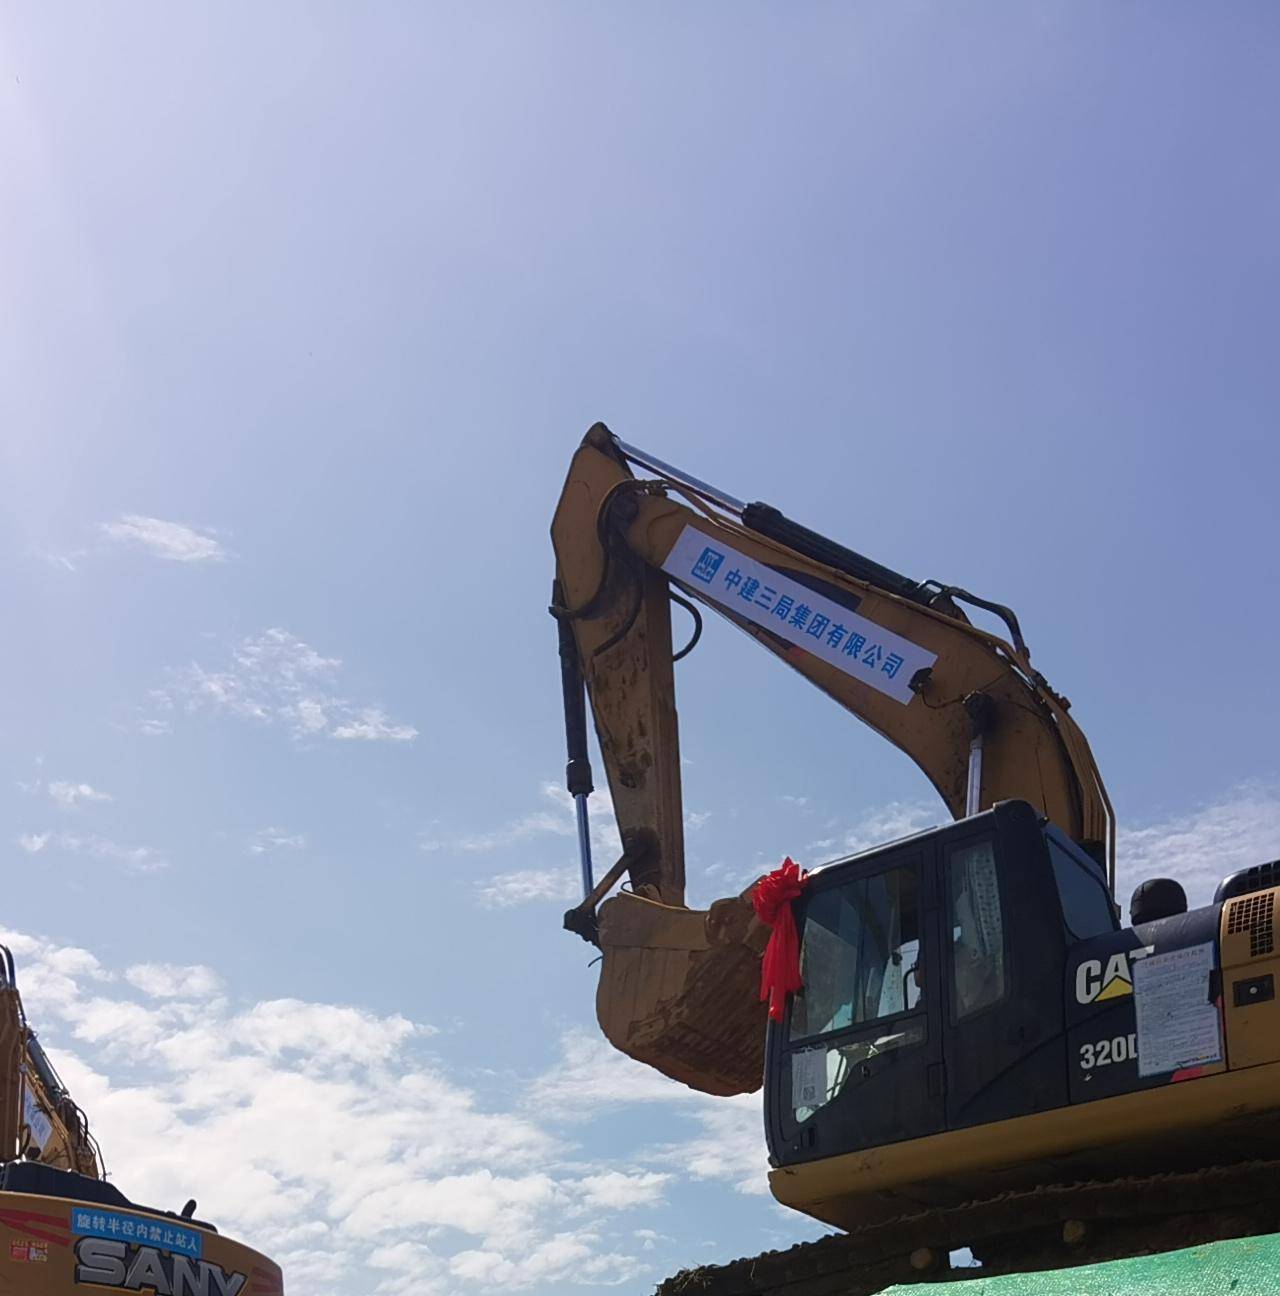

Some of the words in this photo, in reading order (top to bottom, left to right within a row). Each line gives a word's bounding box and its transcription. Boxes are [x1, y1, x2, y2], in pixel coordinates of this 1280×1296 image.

[723, 568, 905, 680] 中建三局集团有限公司
[76, 1213, 198, 1252] 旋转半径内禁止站人
